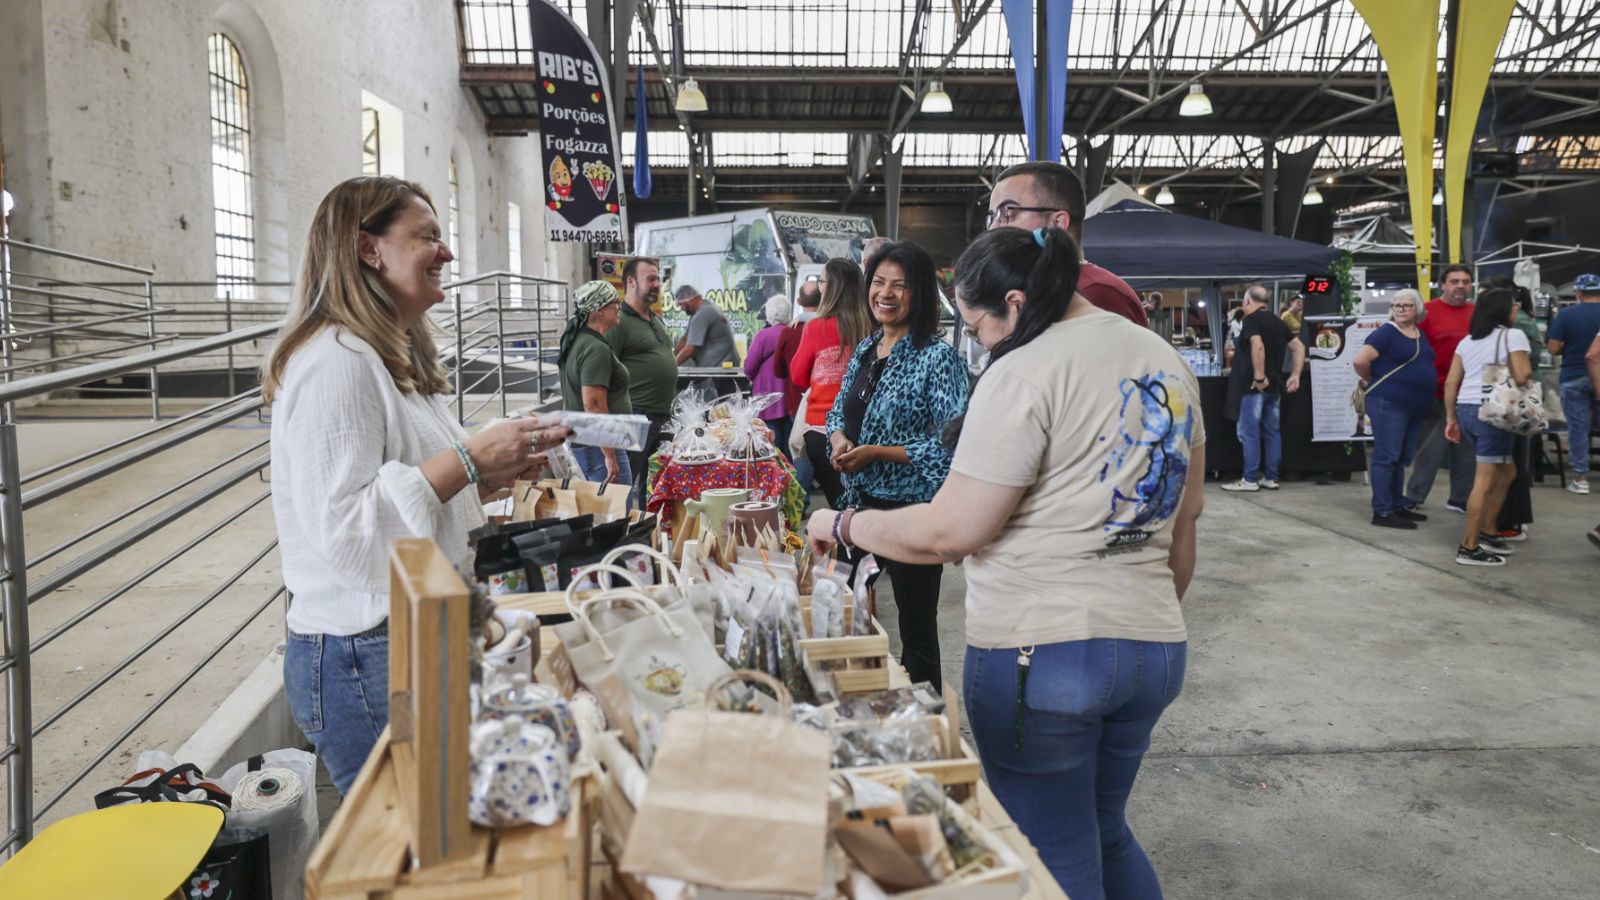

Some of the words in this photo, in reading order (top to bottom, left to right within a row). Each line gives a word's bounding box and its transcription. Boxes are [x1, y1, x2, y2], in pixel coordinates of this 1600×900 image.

[538, 51, 599, 86] RIB'S
[543, 103, 606, 125] Porções
[545, 134, 609, 154] Fogazza
[780, 216, 821, 231] CALDO
[838, 220, 871, 233] CANA
[550, 229, 561, 242] 11
